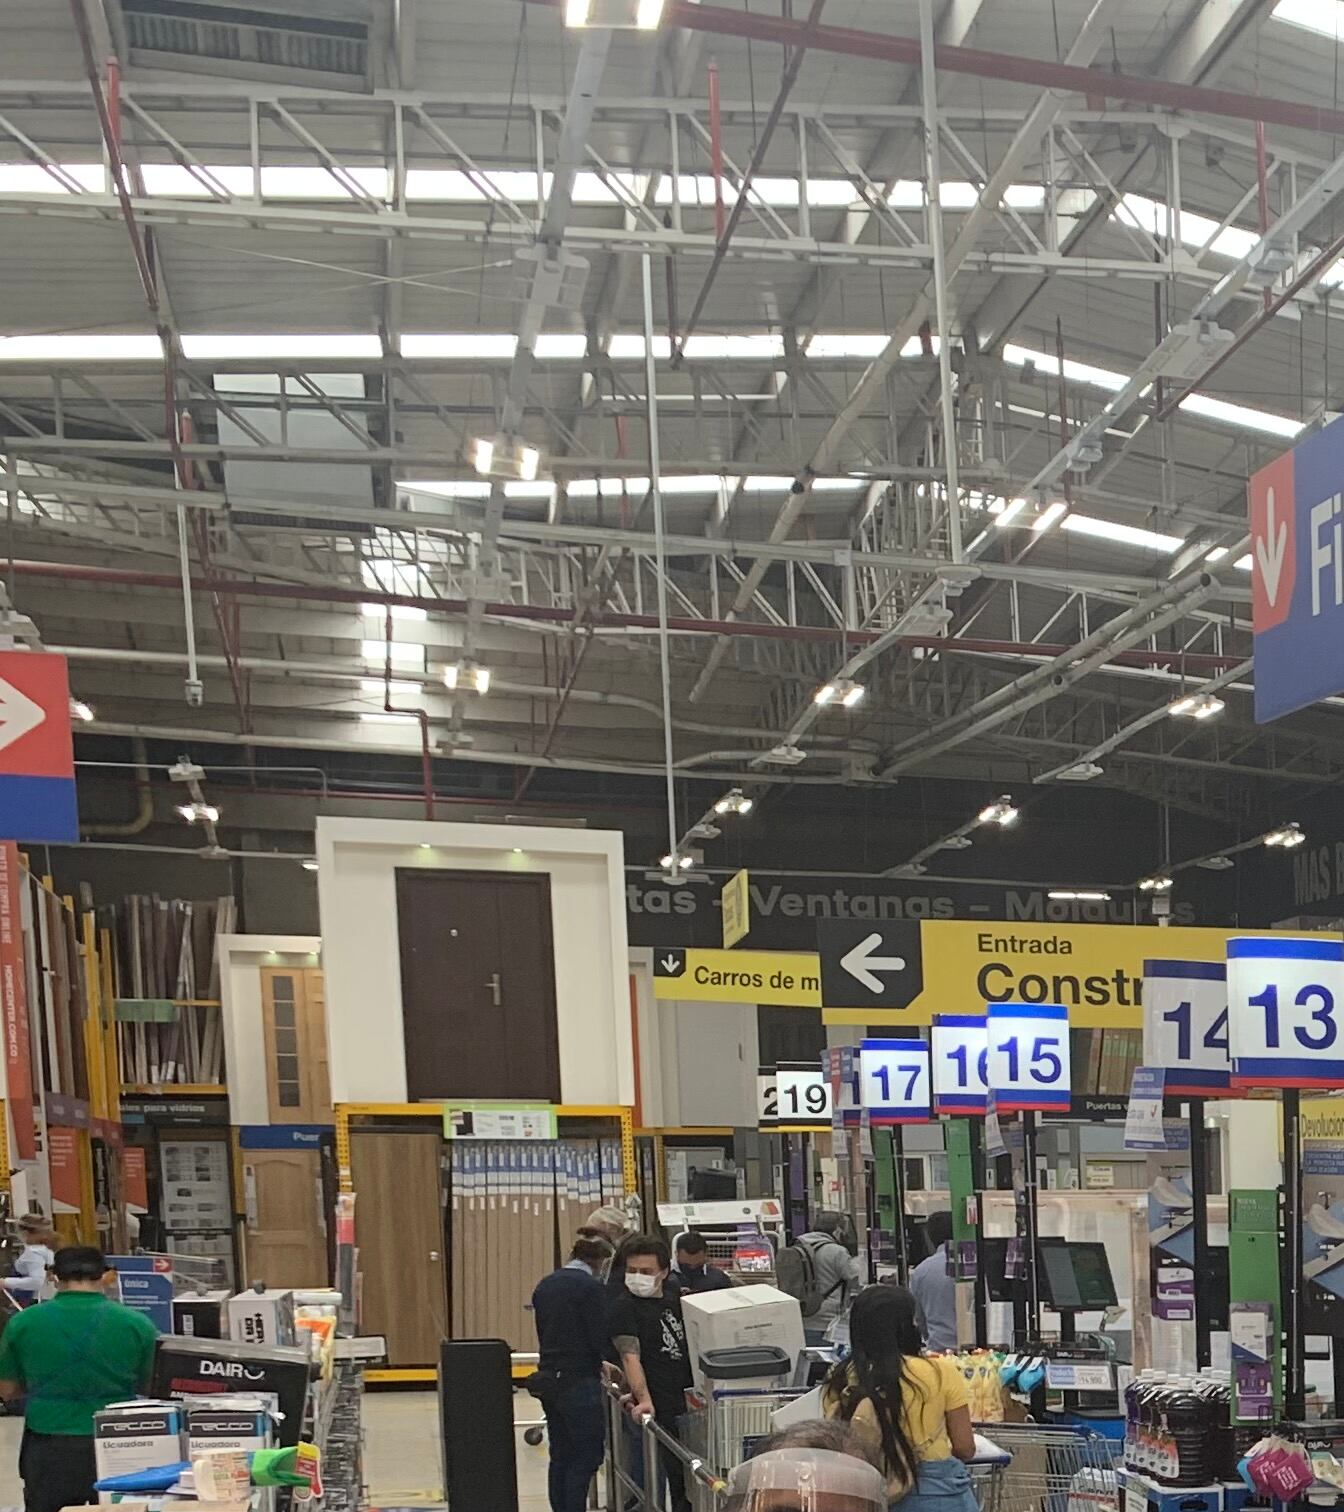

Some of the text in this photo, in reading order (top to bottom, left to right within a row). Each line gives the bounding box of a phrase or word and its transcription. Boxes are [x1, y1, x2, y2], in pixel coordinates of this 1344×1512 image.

[627, 884, 954, 918] tas Ventanas
[977, 933, 1072, 955] Entrada
[694, 965, 794, 990] Carros de
[1248, 984, 1338, 1051] 13
[1163, 1002, 1231, 1062] 14
[997, 1036, 1062, 1084] 15
[872, 1065, 921, 1101] 17
[144, 1103, 205, 1114] para vidrios
[784, 1084, 826, 1114] 19
[1086, 1102, 1121, 1111] Puertas
[124, 1276, 149, 1289] única
[103, 1438, 154, 1450] Licuadora
[191, 1440, 241, 1449] Licuadora
